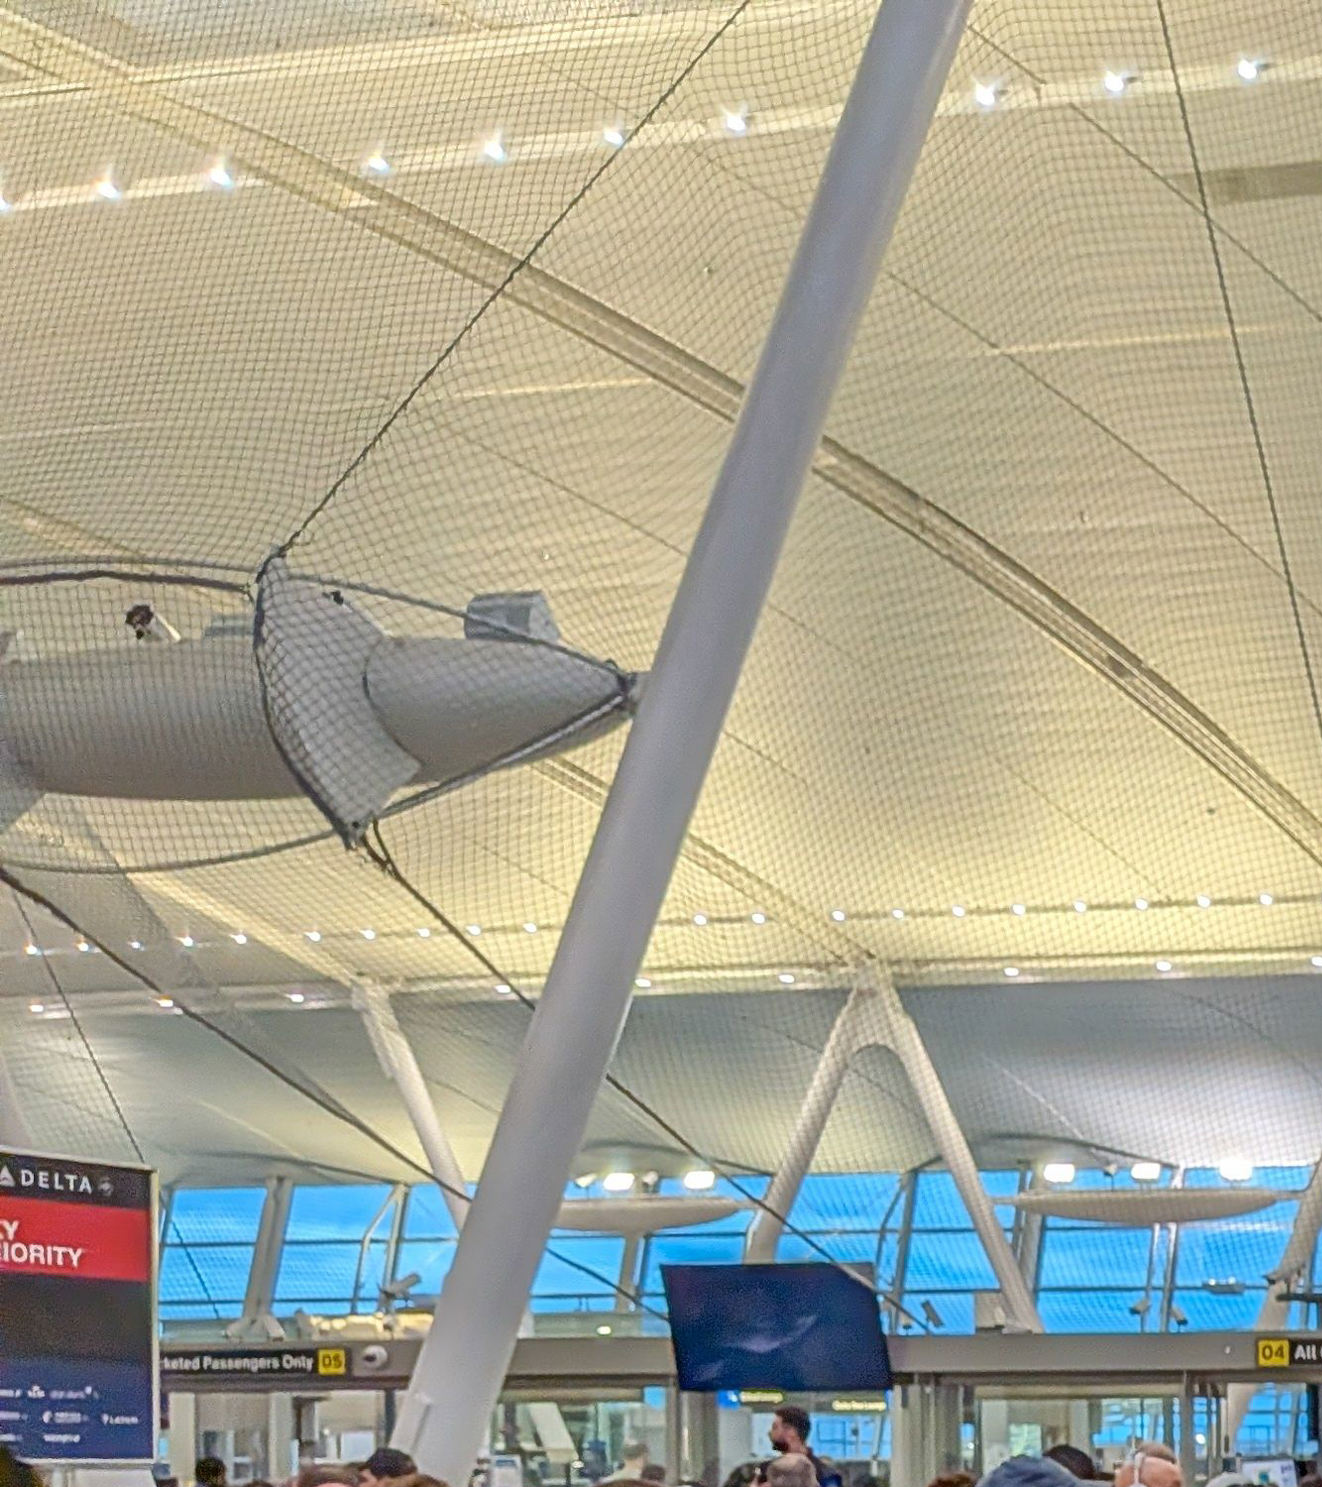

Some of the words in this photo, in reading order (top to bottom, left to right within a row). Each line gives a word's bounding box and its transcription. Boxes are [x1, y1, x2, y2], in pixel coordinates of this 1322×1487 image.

[20, 1169, 93, 1194] DELTA
[1261, 1344, 1285, 1360] 04
[1294, 1344, 1316, 1360] All
[161, 1356, 199, 1371] keted
[203, 1355, 280, 1373] Passengers
[282, 1354, 313, 1371] Only
